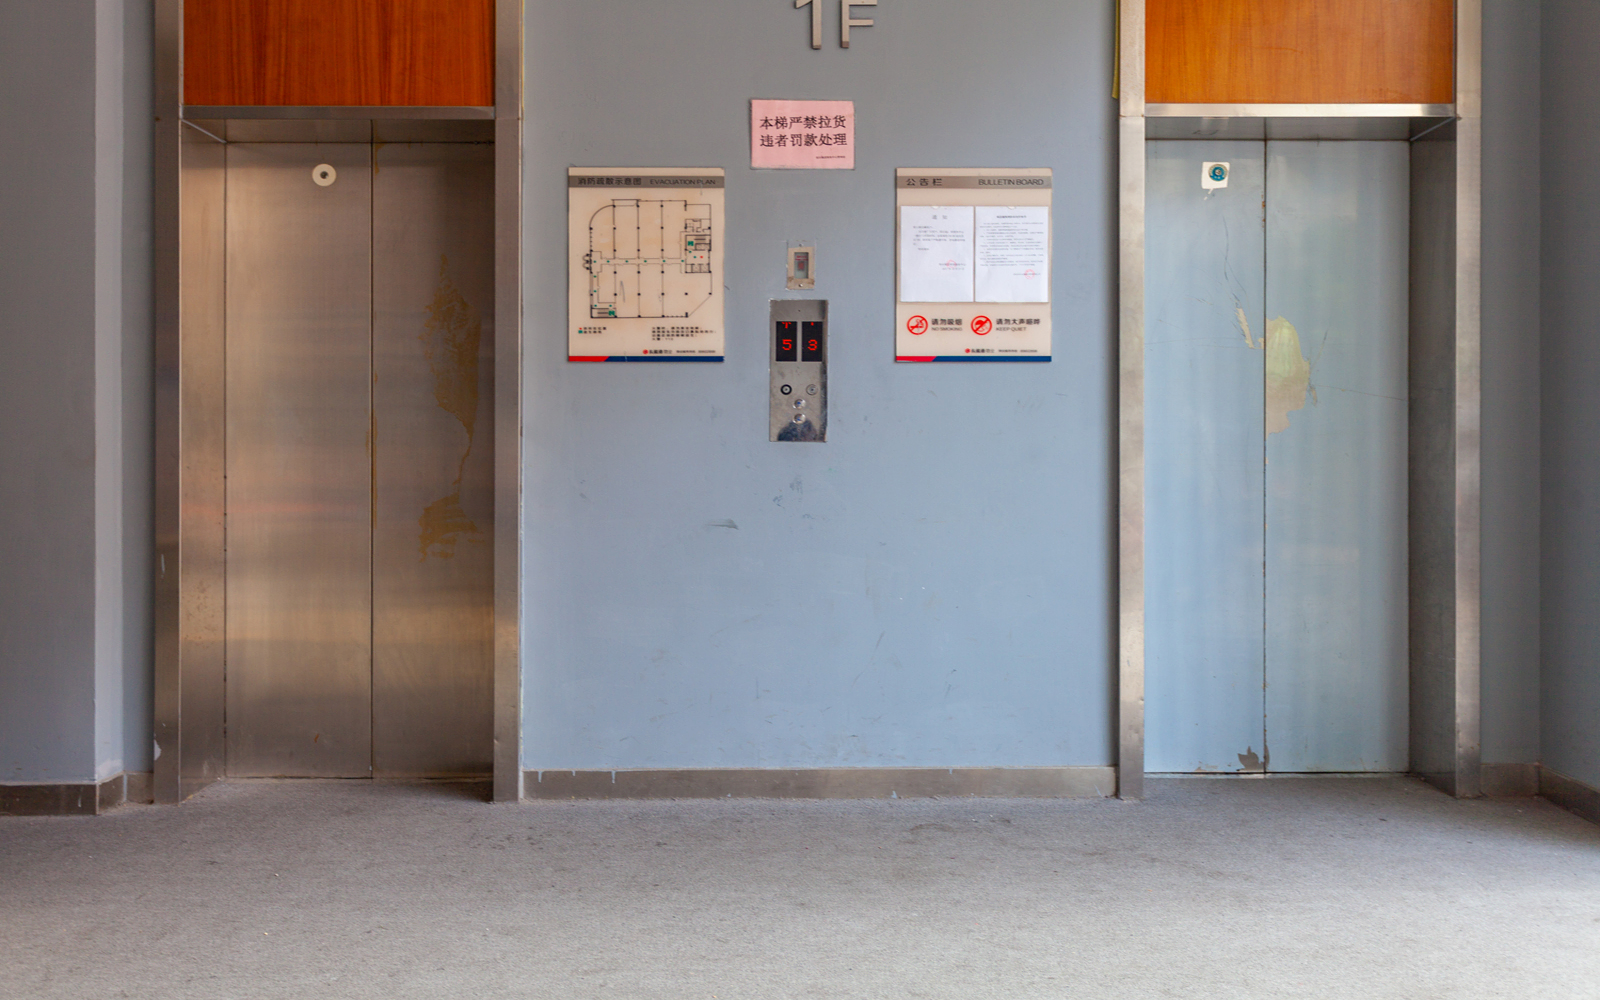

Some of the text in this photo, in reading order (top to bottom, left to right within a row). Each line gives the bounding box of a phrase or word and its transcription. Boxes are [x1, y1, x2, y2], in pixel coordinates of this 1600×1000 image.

[759, 115, 846, 130] 本梯严禁拉货
[759, 133, 848, 148] 违者罚款处理
[577, 177, 643, 186] 消防疏散示意图
[650, 178, 716, 186] EVACUATION PLAN
[905, 177, 943, 187] 公告栏
[978, 178, 1044, 186] BULLETIN BOARD
[931, 318, 963, 326] 请勿吸烟
[995, 318, 1041, 326] 请勿大声喧哗
[782, 339, 792, 350] 5
[807, 339, 818, 350] 3
